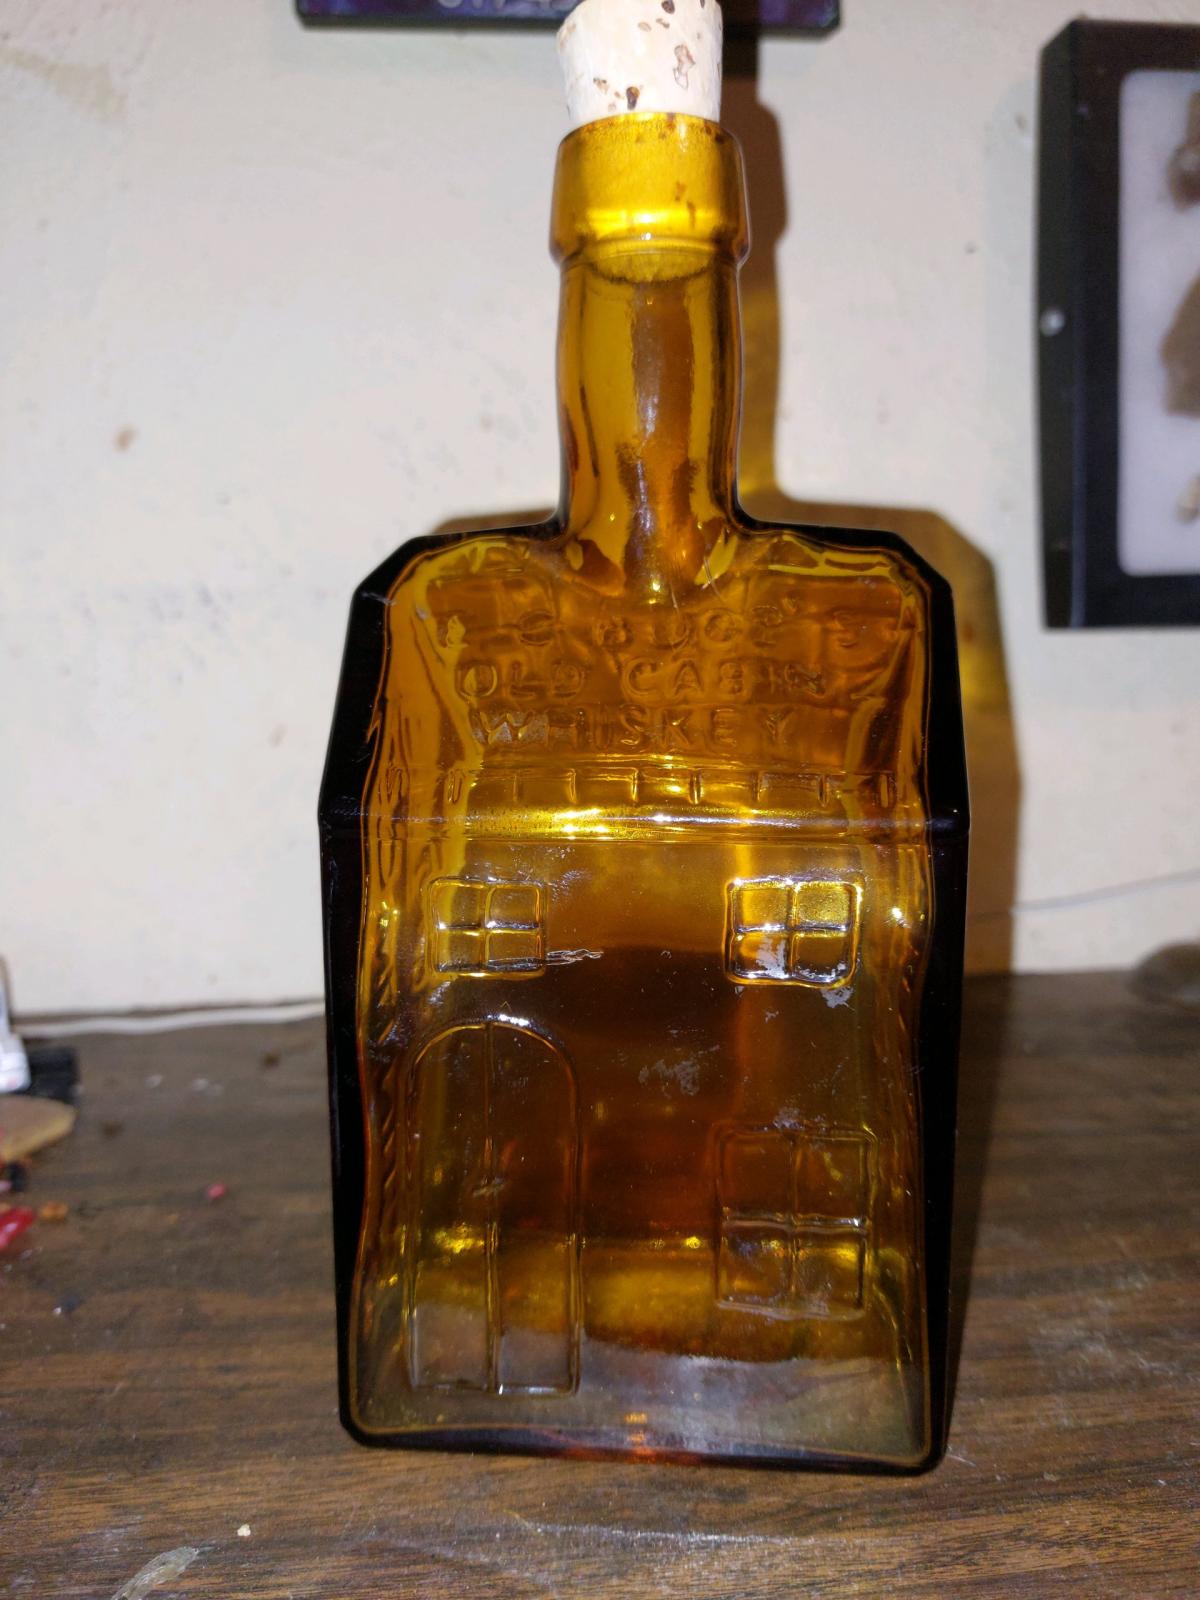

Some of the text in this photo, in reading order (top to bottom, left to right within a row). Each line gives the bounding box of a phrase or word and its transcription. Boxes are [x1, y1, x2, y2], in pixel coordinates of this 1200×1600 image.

[457, 656, 831, 701] OLD CABIN
[470, 703, 796, 752] WHISKEY
